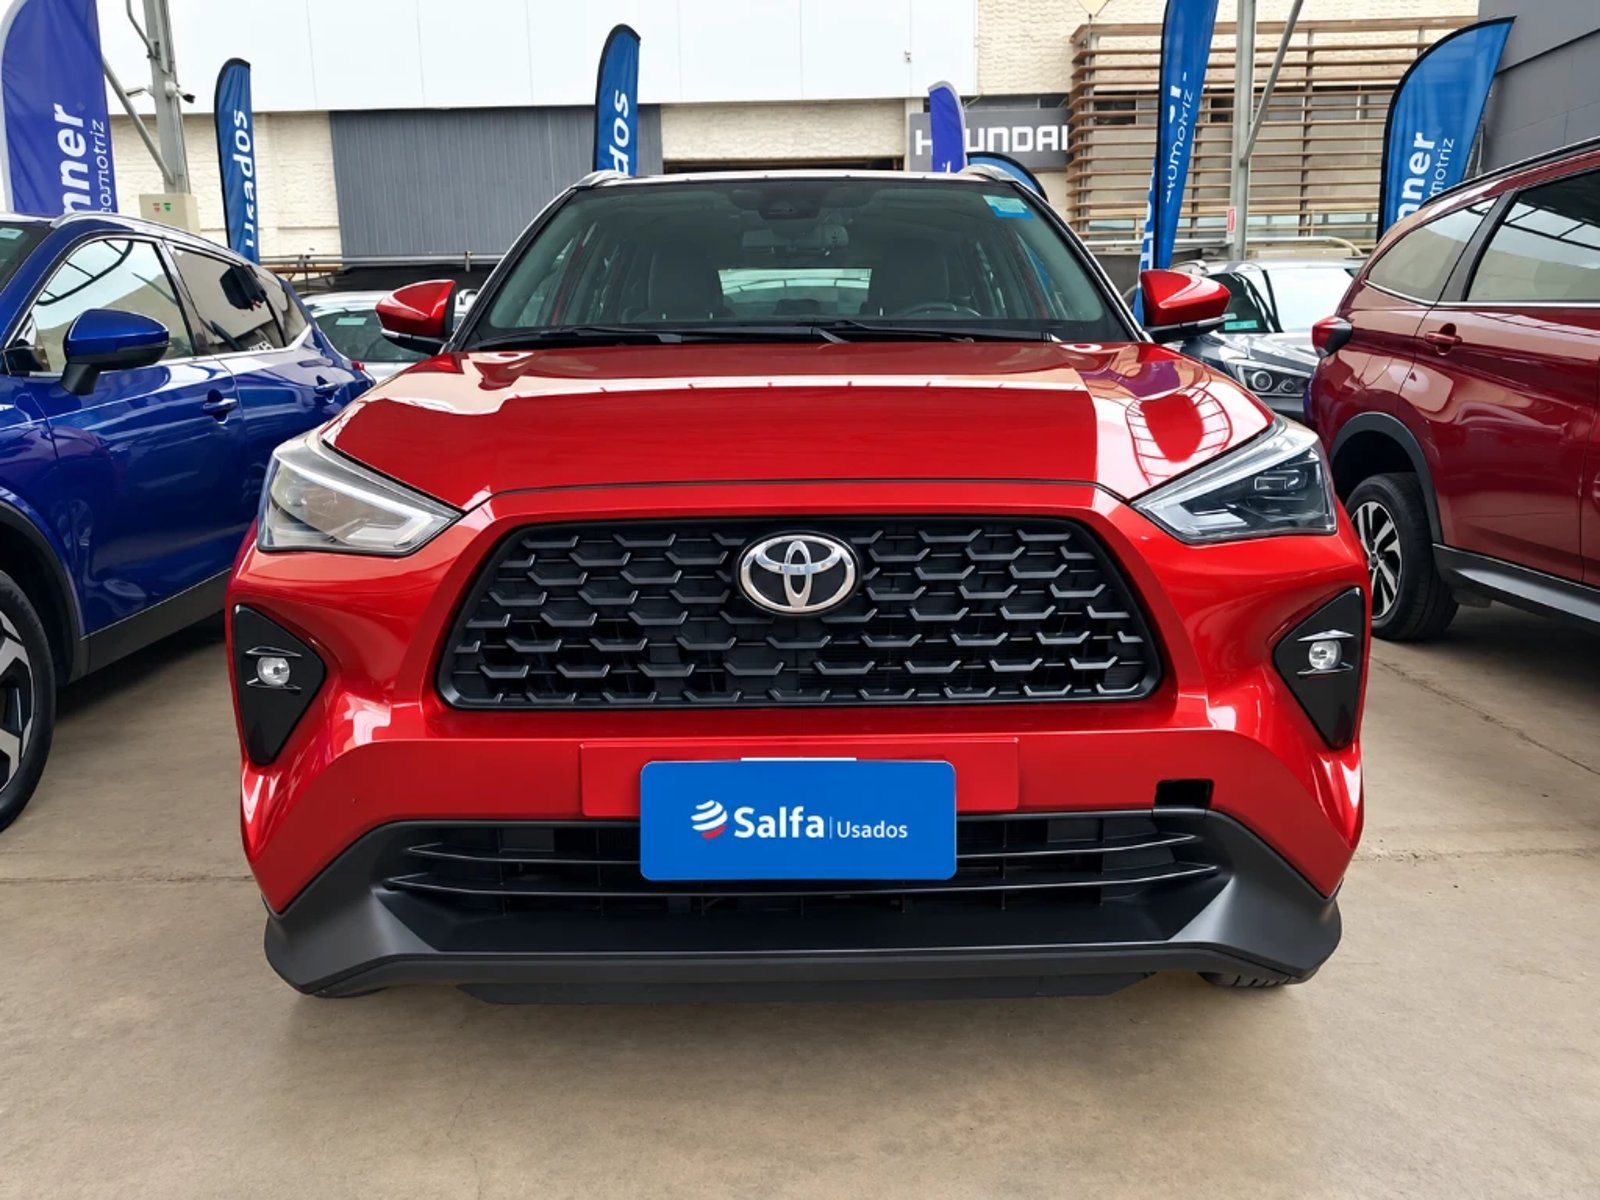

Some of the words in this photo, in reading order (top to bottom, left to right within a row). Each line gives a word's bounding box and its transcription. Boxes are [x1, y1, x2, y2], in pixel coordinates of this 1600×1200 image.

[915, 125, 1069, 155] HUNDAI
[734, 806, 824, 839] Salfa
[836, 820, 908, 839] Usados
